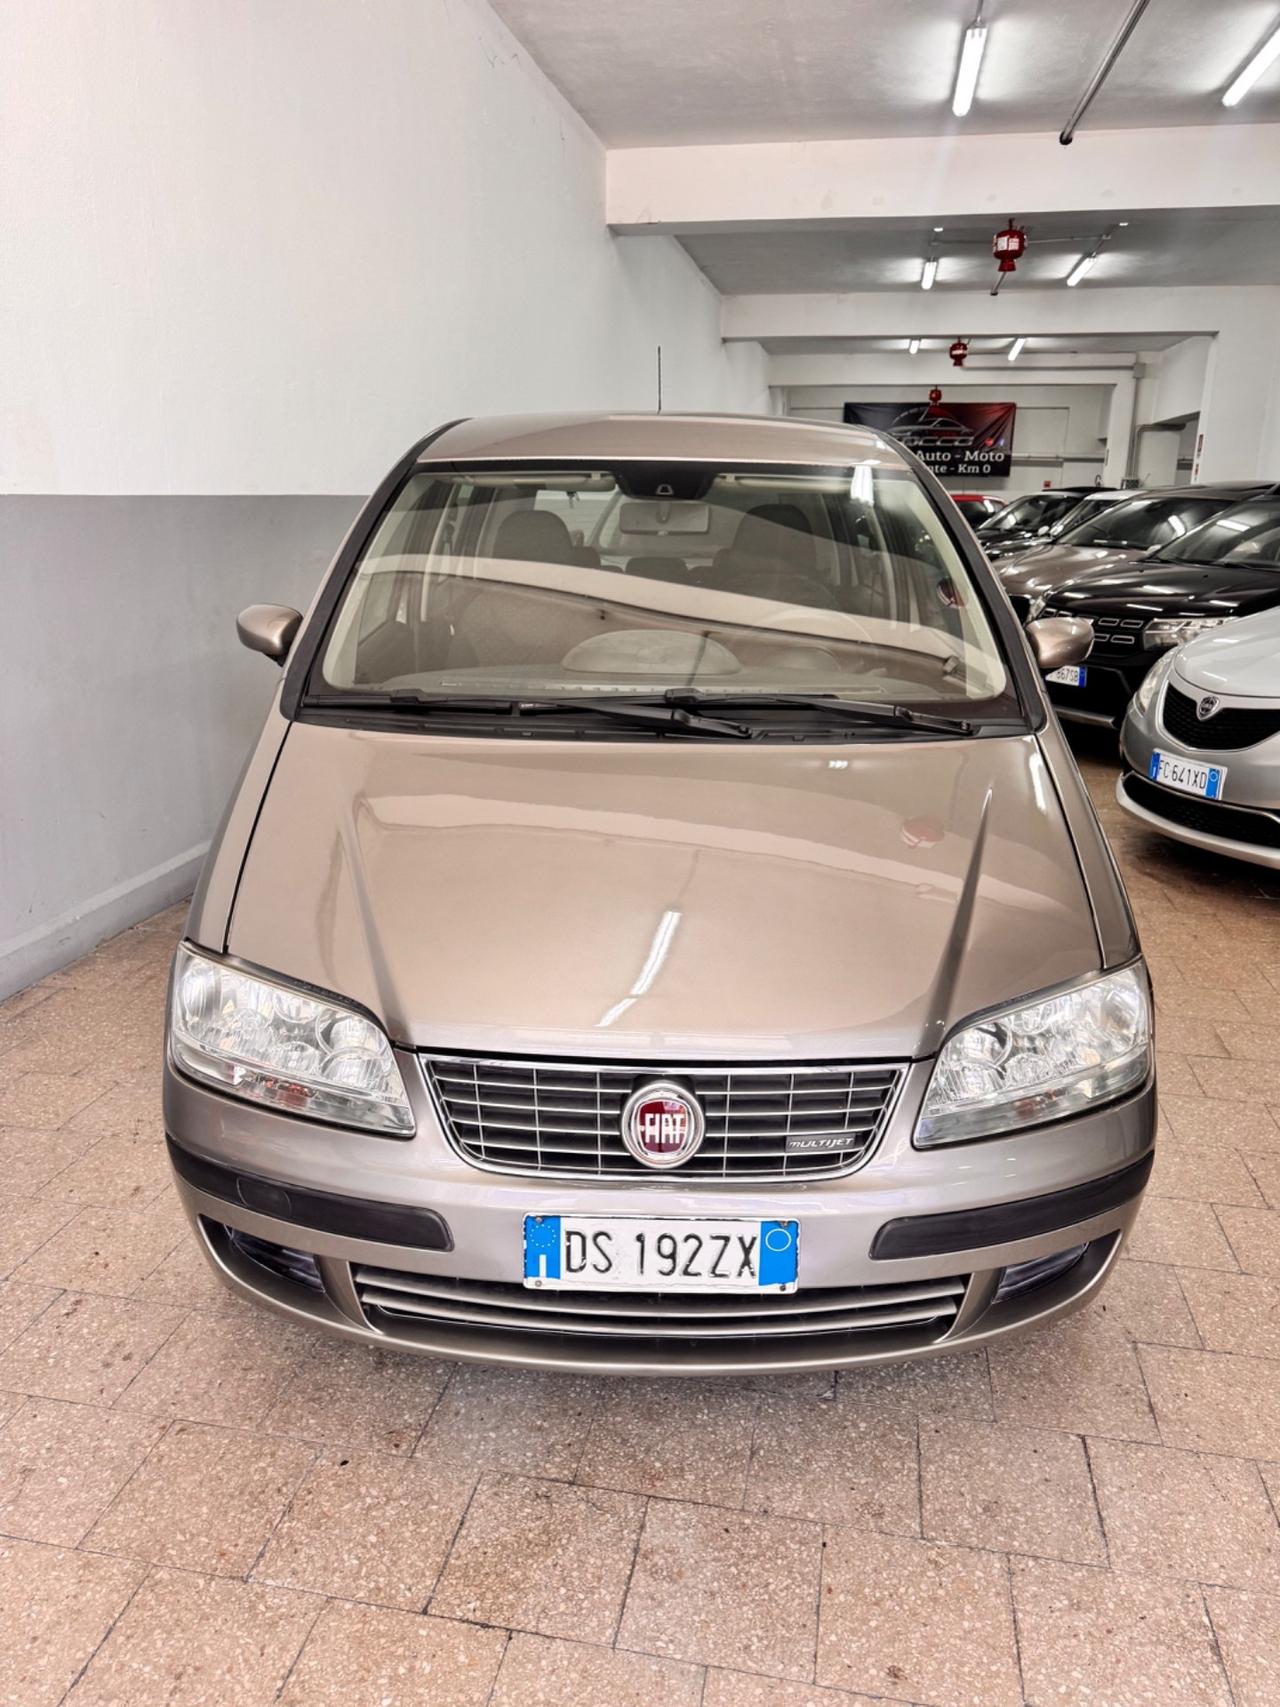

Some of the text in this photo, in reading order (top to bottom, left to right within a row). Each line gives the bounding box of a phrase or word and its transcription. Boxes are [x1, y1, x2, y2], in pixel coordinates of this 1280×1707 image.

[916, 450, 951, 461] Auto
[964, 450, 1005, 461] Moto
[957, 463, 980, 473] Km
[982, 463, 991, 473] 0
[1159, 760, 1208, 789] FC 641XD
[644, 1113, 684, 1144] FIAT
[565, 1230, 757, 1279] DS 192ZX
